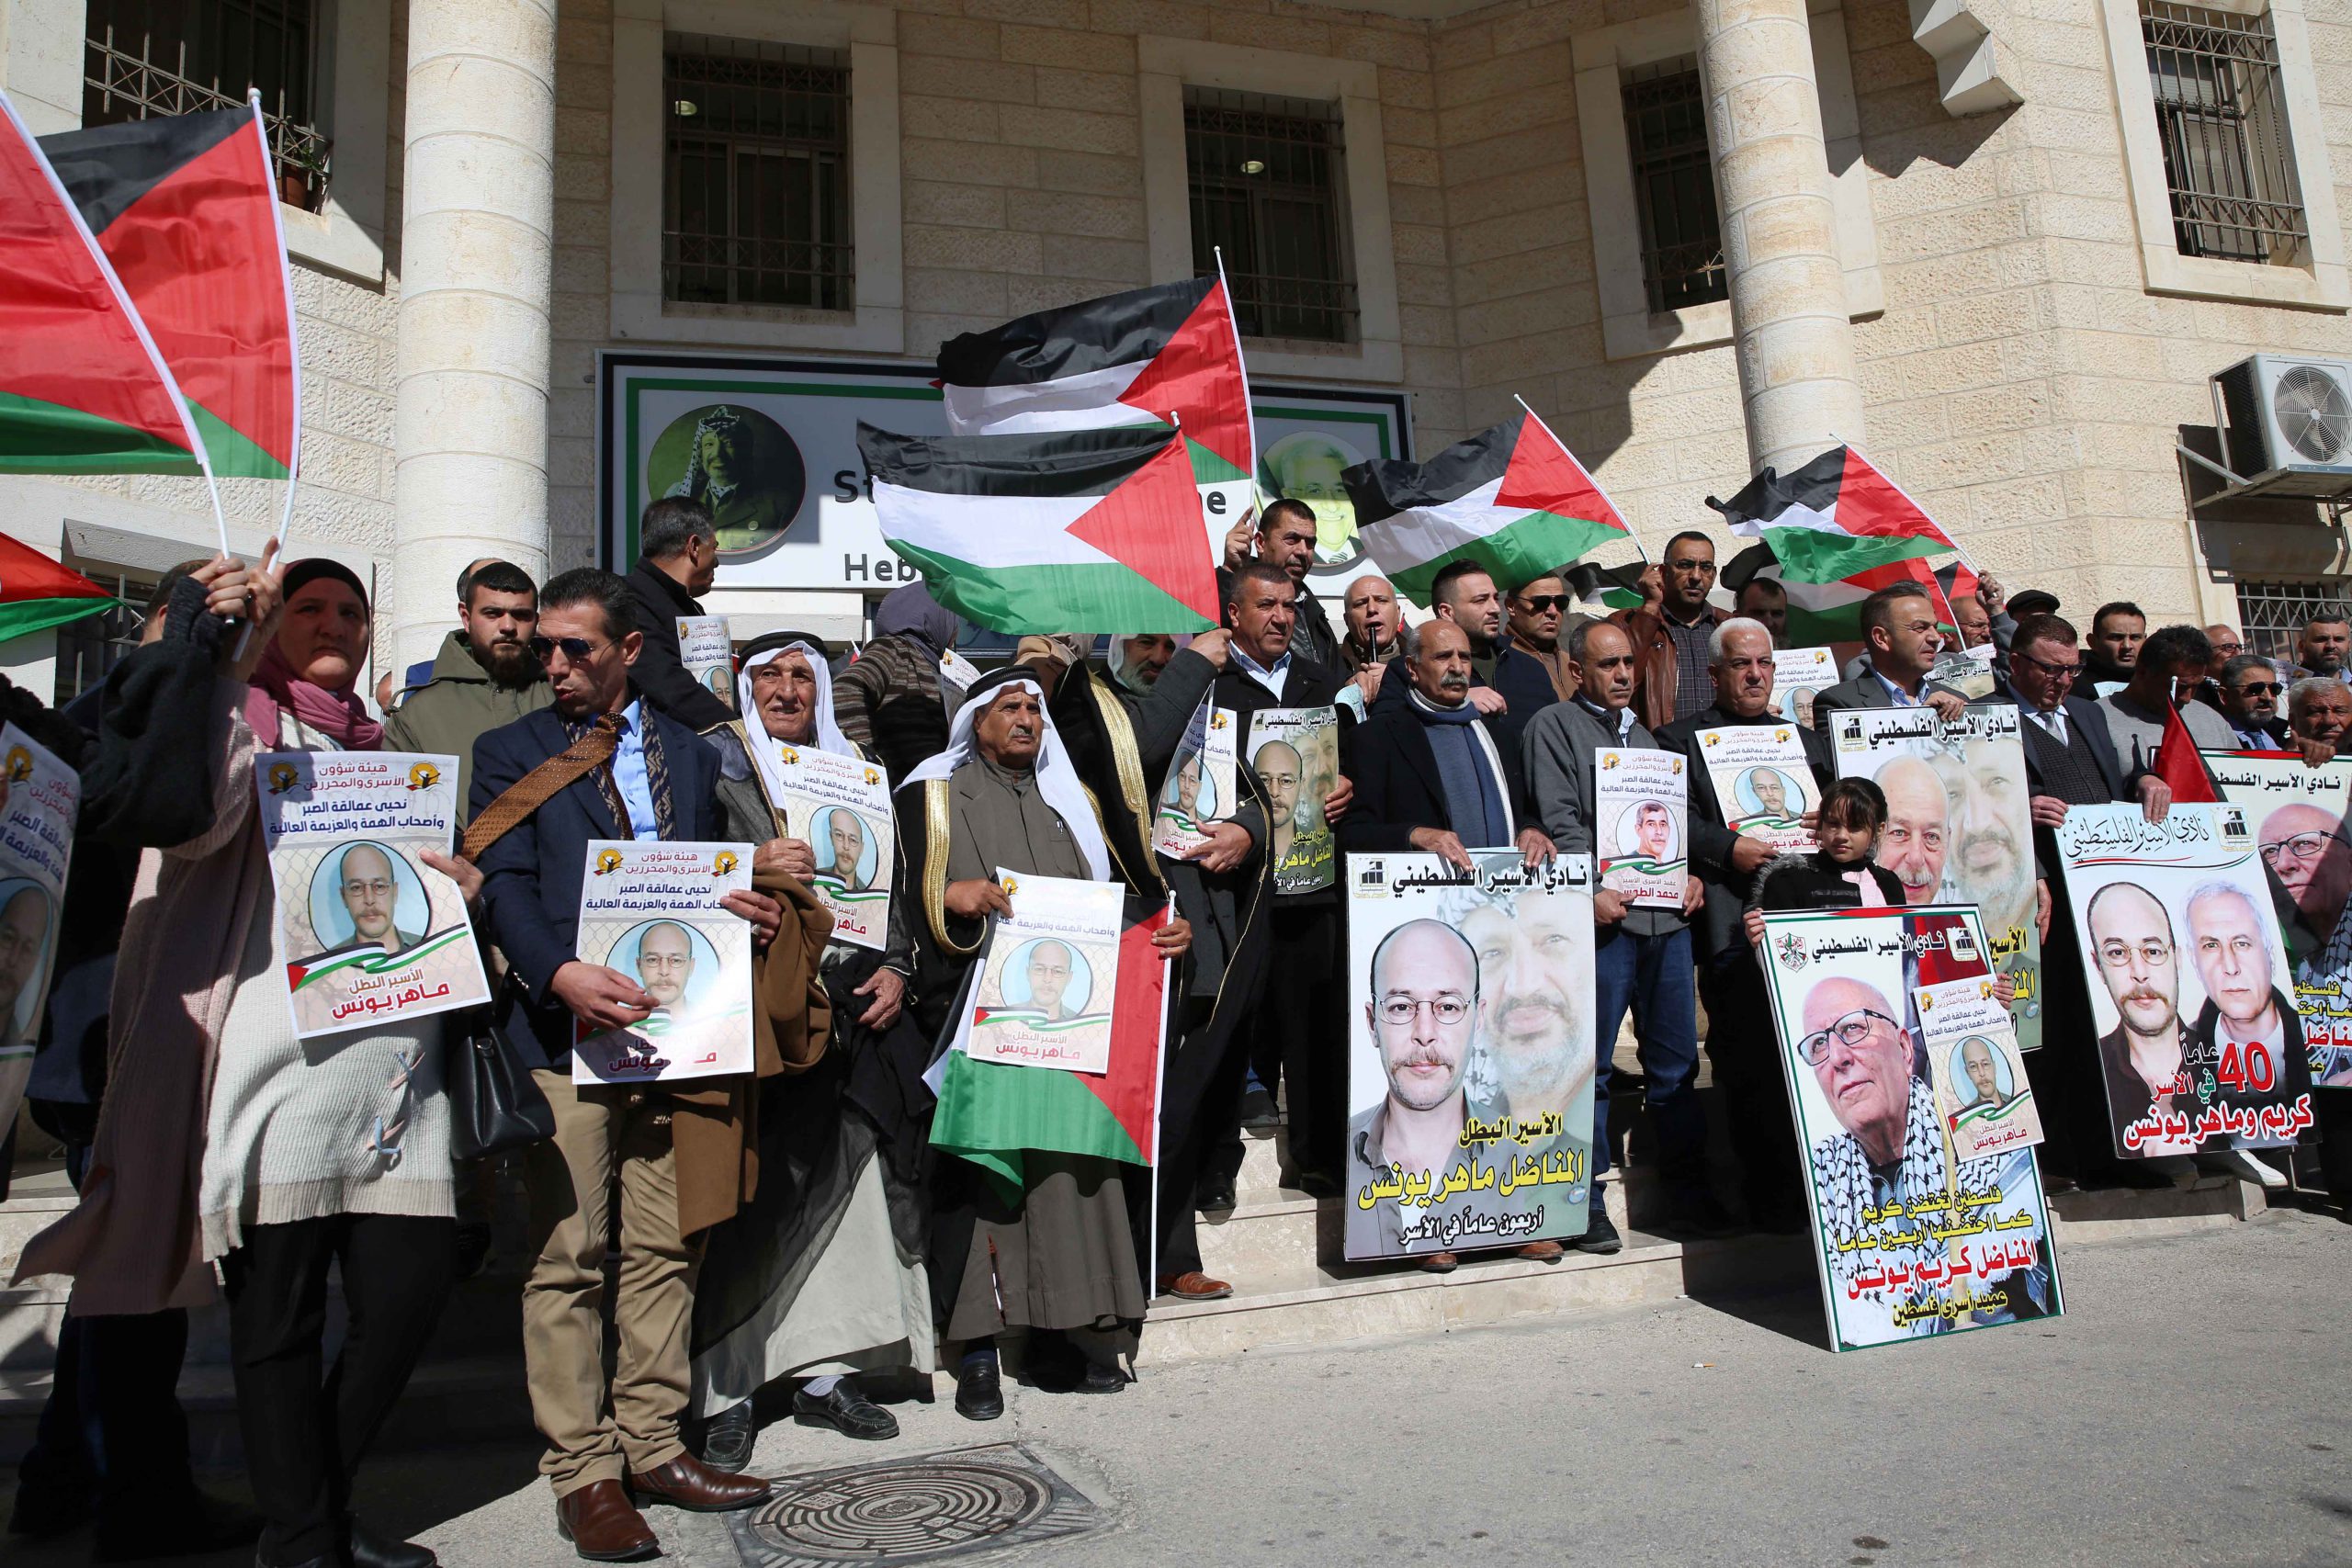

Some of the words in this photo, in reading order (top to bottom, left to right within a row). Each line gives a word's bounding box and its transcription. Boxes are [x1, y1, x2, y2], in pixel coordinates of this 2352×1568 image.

[1869, 717, 1938, 750] الفلسطيني
[1941, 712, 1982, 743] الأسير
[1984, 714, 2017, 742] نادي
[320, 761, 355, 775] شؤون
[358, 762, 388, 774] هيئة
[304, 779, 364, 791] والمحررين
[364, 778, 404, 788] الأسرى
[784, 780, 808, 790] العالية
[804, 776, 820, 784] الصبر
[822, 780, 847, 790] عمالقة
[2217, 772, 2260, 786] الفلسط
[2264, 773, 2304, 792] الأسير
[2307, 775, 2341, 795] نادي
[809, 788, 841, 800] والعزيمة
[842, 795, 864, 805] الهمة
[1625, 786, 1653, 795] والعزيمة
[303, 802, 328, 817] الصبر
[332, 802, 372, 812] عمالقة
[865, 802, 888, 815] وأصحاب
[270, 821, 307, 837] العالية
[311, 818, 357, 834] والعزيمة
[361, 817, 395, 828] الهمة
[398, 817, 445, 830] وأصحاب
[641, 850, 672, 863] شؤون
[674, 851, 697, 862] هيئة
[626, 864, 678, 875] والمحررين
[678, 865, 710, 874] الأسرى
[1487, 859, 1541, 894] الأسير
[1544, 863, 1588, 896] نادي
[619, 884, 643, 895] الصبر
[646, 884, 683, 893] عمالقة
[1392, 864, 1483, 898] الفلسطيني
[586, 898, 620, 911] العالية
[623, 898, 667, 911] والعزيمة
[671, 899, 701, 909] الهمة
[1657, 890, 1679, 899] محمد
[838, 905, 857, 916] الأسير
[837, 919, 866, 934] ماهر
[1812, 935, 1872, 964] الفلسطيني
[1876, 932, 1914, 956] الأسير
[1915, 931, 1946, 958] نادي
[349, 976, 385, 994] البطل
[387, 967, 424, 988] الأسير
[397, 983, 450, 1009] ماهر
[2293, 980, 2342, 998] فلسطي
[332, 995, 393, 1019] يونس
[996, 1043, 1039, 1058] يونس
[1042, 1046, 1080, 1060] ماهر
[2178, 1031, 2220, 1066] عاماً
[2218, 1041, 2276, 1093] 40
[2151, 1069, 2194, 1102] الأسر
[2197, 1069, 2217, 1104] في
[1998, 1118, 2014, 1131] الأسير
[2123, 1103, 2190, 1149] يونس
[2194, 1101, 2257, 1143] وماهر
[2262, 1094, 2313, 1140] كريم
[1458, 1116, 1511, 1147] البطل
[1512, 1111, 1563, 1145] الأسير
[1980, 1122, 1997, 1134] البطل
[2003, 1128, 2028, 1144] ماهر
[1973, 1135, 2001, 1150] يونس
[1433, 1157, 1495, 1203] ماهر
[1498, 1148, 1585, 1197] المناضل
[1358, 1161, 1432, 1211] يونس
[1906, 1190, 1952, 1220] تحتضن
[1954, 1184, 2003, 1214] فلسطين
[1498, 1204, 1544, 1237] أربعون
[1861, 1197, 1904, 1225] كريم
[1993, 1209, 2034, 1232] كما
[1398, 1214, 1441, 1246] الأسر
[1442, 1214, 1462, 1246] في
[1462, 1208, 1497, 1236] عاماً
[1929, 1213, 1992, 1244] احتضنها
[1880, 1224, 1928, 1251] أربعين
[1915, 1245, 1973, 1291] كريم
[1977, 1237, 2038, 1279] المناضل
[1848, 1257, 1910, 1301] يونس
[1892, 1296, 1939, 1327] فلسطين
[1940, 1289, 1974, 1320] أسرى
[1975, 1290, 2008, 1314] عميد
